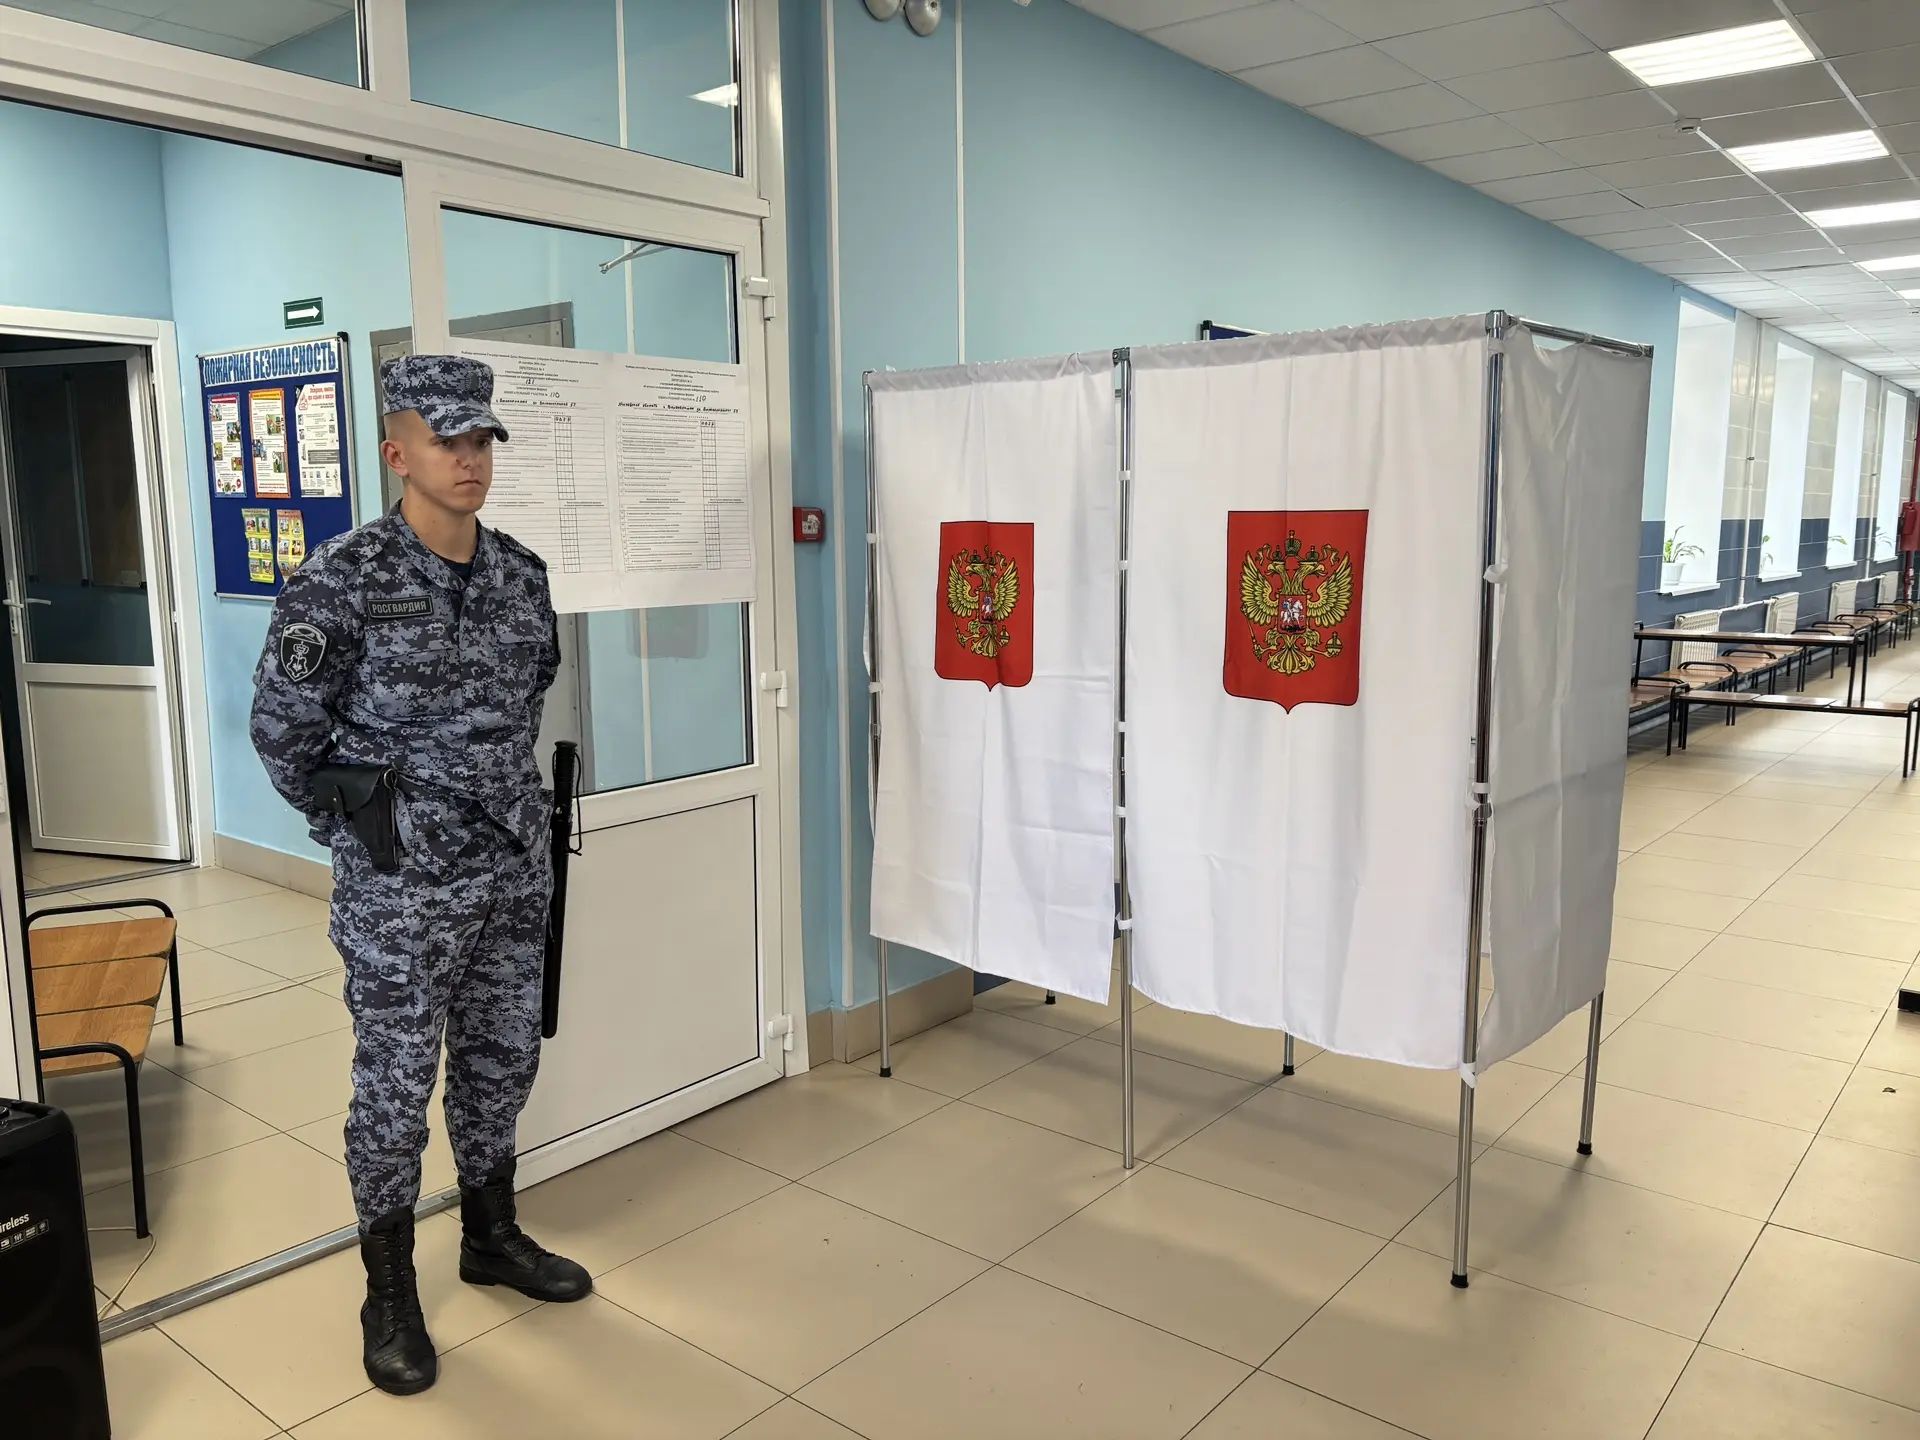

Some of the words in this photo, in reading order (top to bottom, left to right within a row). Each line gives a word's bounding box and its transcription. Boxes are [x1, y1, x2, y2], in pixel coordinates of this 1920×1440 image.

[204, 352, 251, 385] ПОЖАРНАЯ
[253, 342, 336, 379] БЕЗОПАСНОСТЬ
[372, 601, 426, 613] РОСГВАРДИЯ
